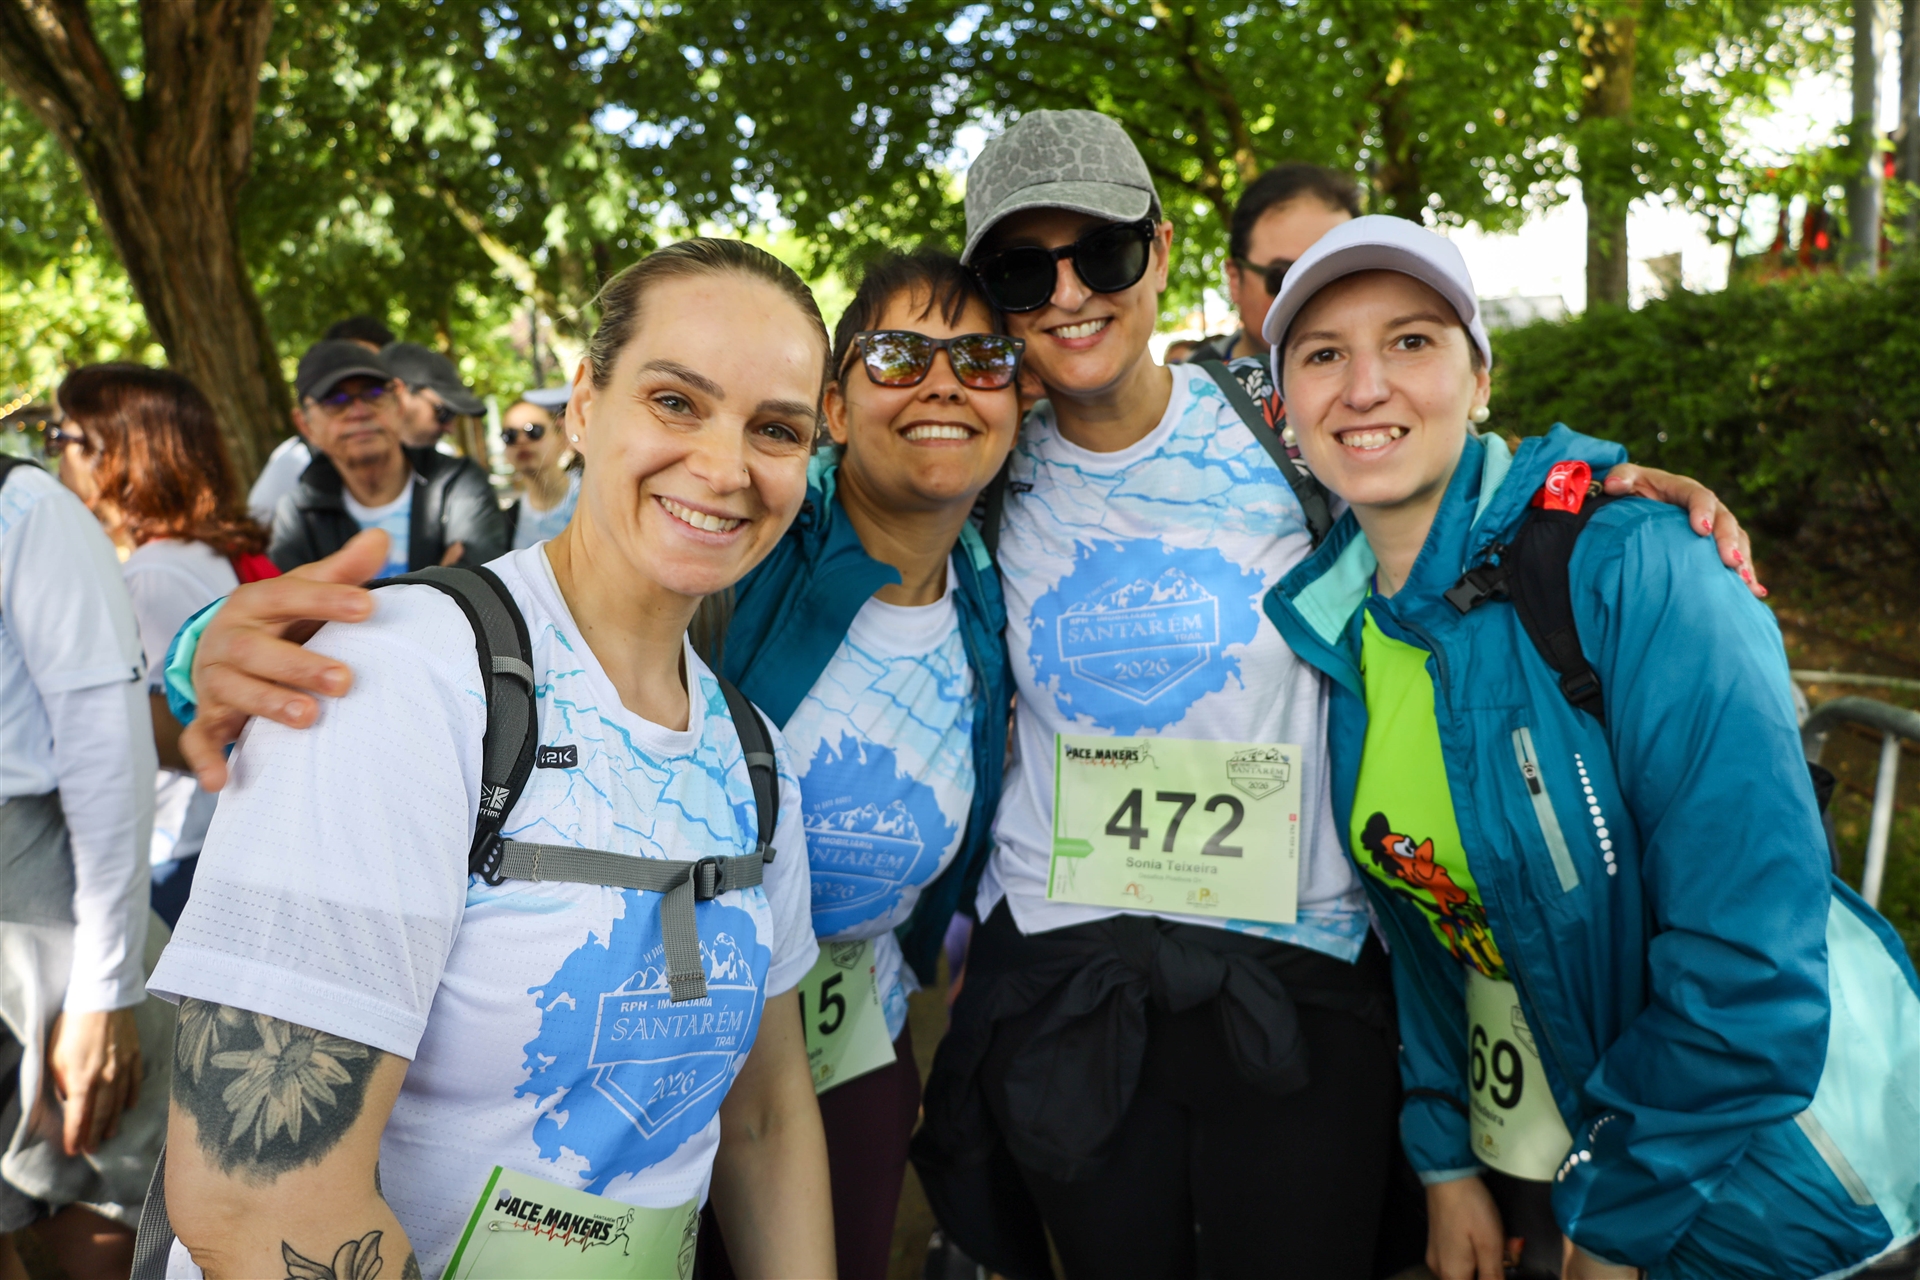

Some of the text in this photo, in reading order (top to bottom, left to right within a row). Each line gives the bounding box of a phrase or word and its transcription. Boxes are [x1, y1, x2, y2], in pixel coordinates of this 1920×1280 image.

[1067, 613, 1203, 644] SANTARÉM
[1174, 632, 1203, 642] TRAIL
[1114, 657, 1171, 680] 2026
[1105, 788, 1245, 859] 472
[810, 846, 905, 870] NTARÉM
[1126, 857, 1218, 874] Sonia Teixeira
[620, 1001, 648, 1013] RPH
[610, 1004, 744, 1041] SANTARÉM
[714, 1036, 736, 1047] TRAIL
[1471, 1024, 1524, 1110] 69
[647, 1069, 697, 1105] 2026
